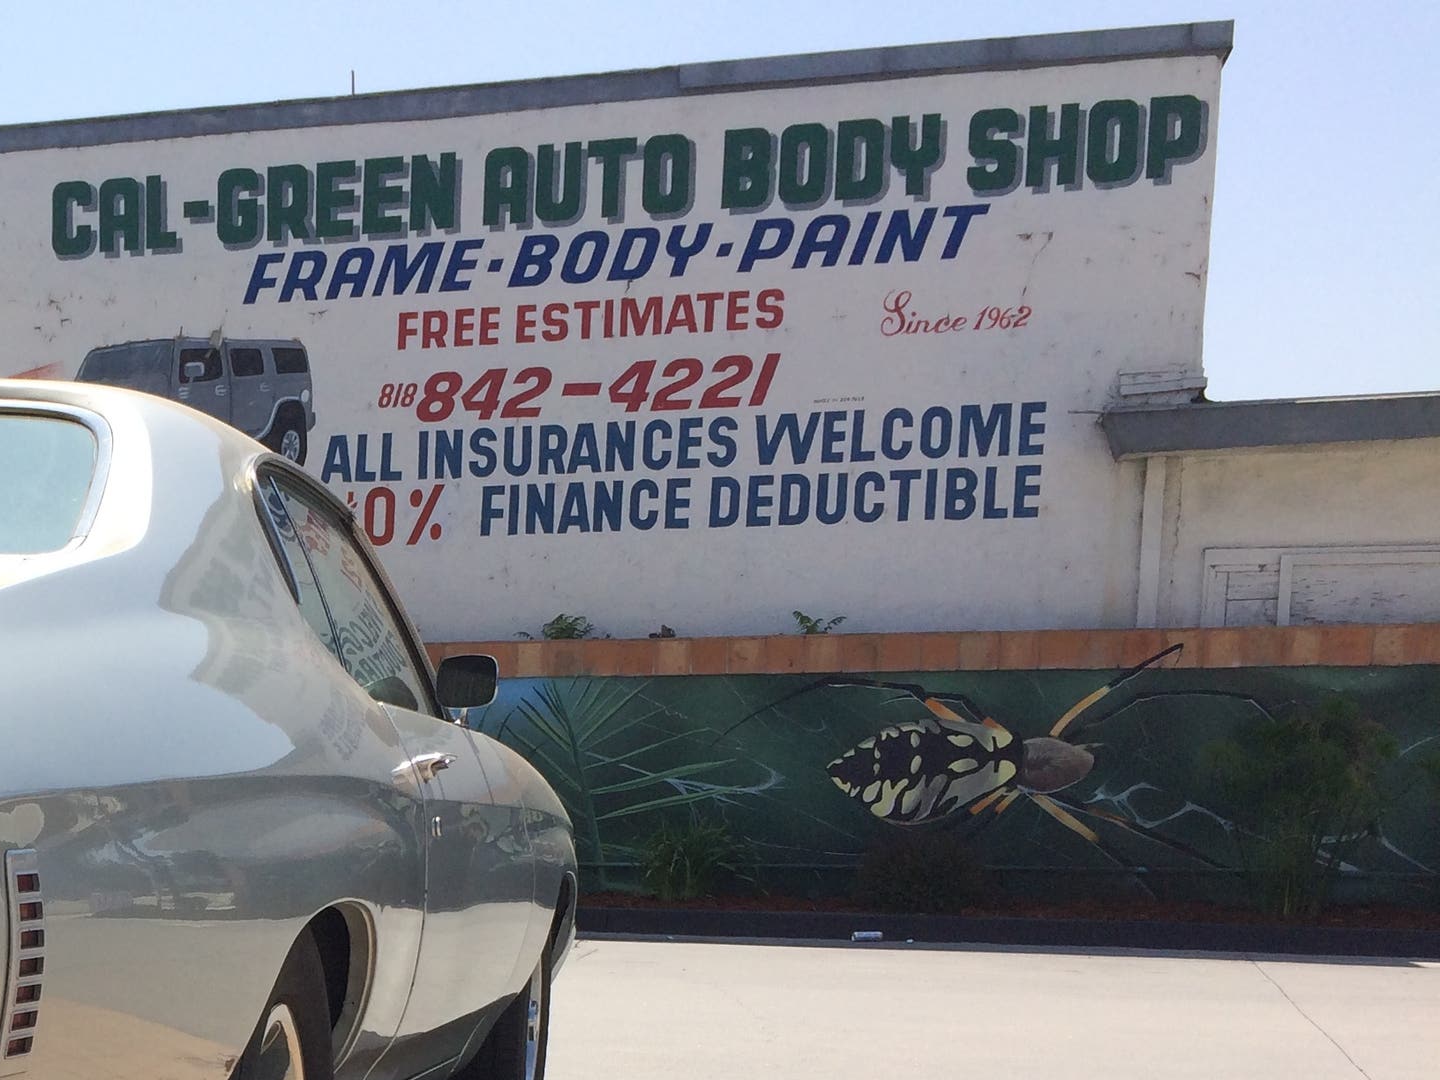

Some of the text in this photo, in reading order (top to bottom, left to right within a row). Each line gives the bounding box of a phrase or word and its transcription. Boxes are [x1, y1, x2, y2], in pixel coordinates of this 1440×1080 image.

[51, 94, 1209, 260] CAL-GREEN AUTO BODY SHOP
[397, 287, 785, 350] FREE ESTIMATES
[880, 290, 1033, 338] Since 1962
[320, 401, 1048, 484] ALL INSURANCES WELCOME
[479, 475, 691, 537] FINANCE
[707, 464, 1043, 529] DEDUCTIBLE
